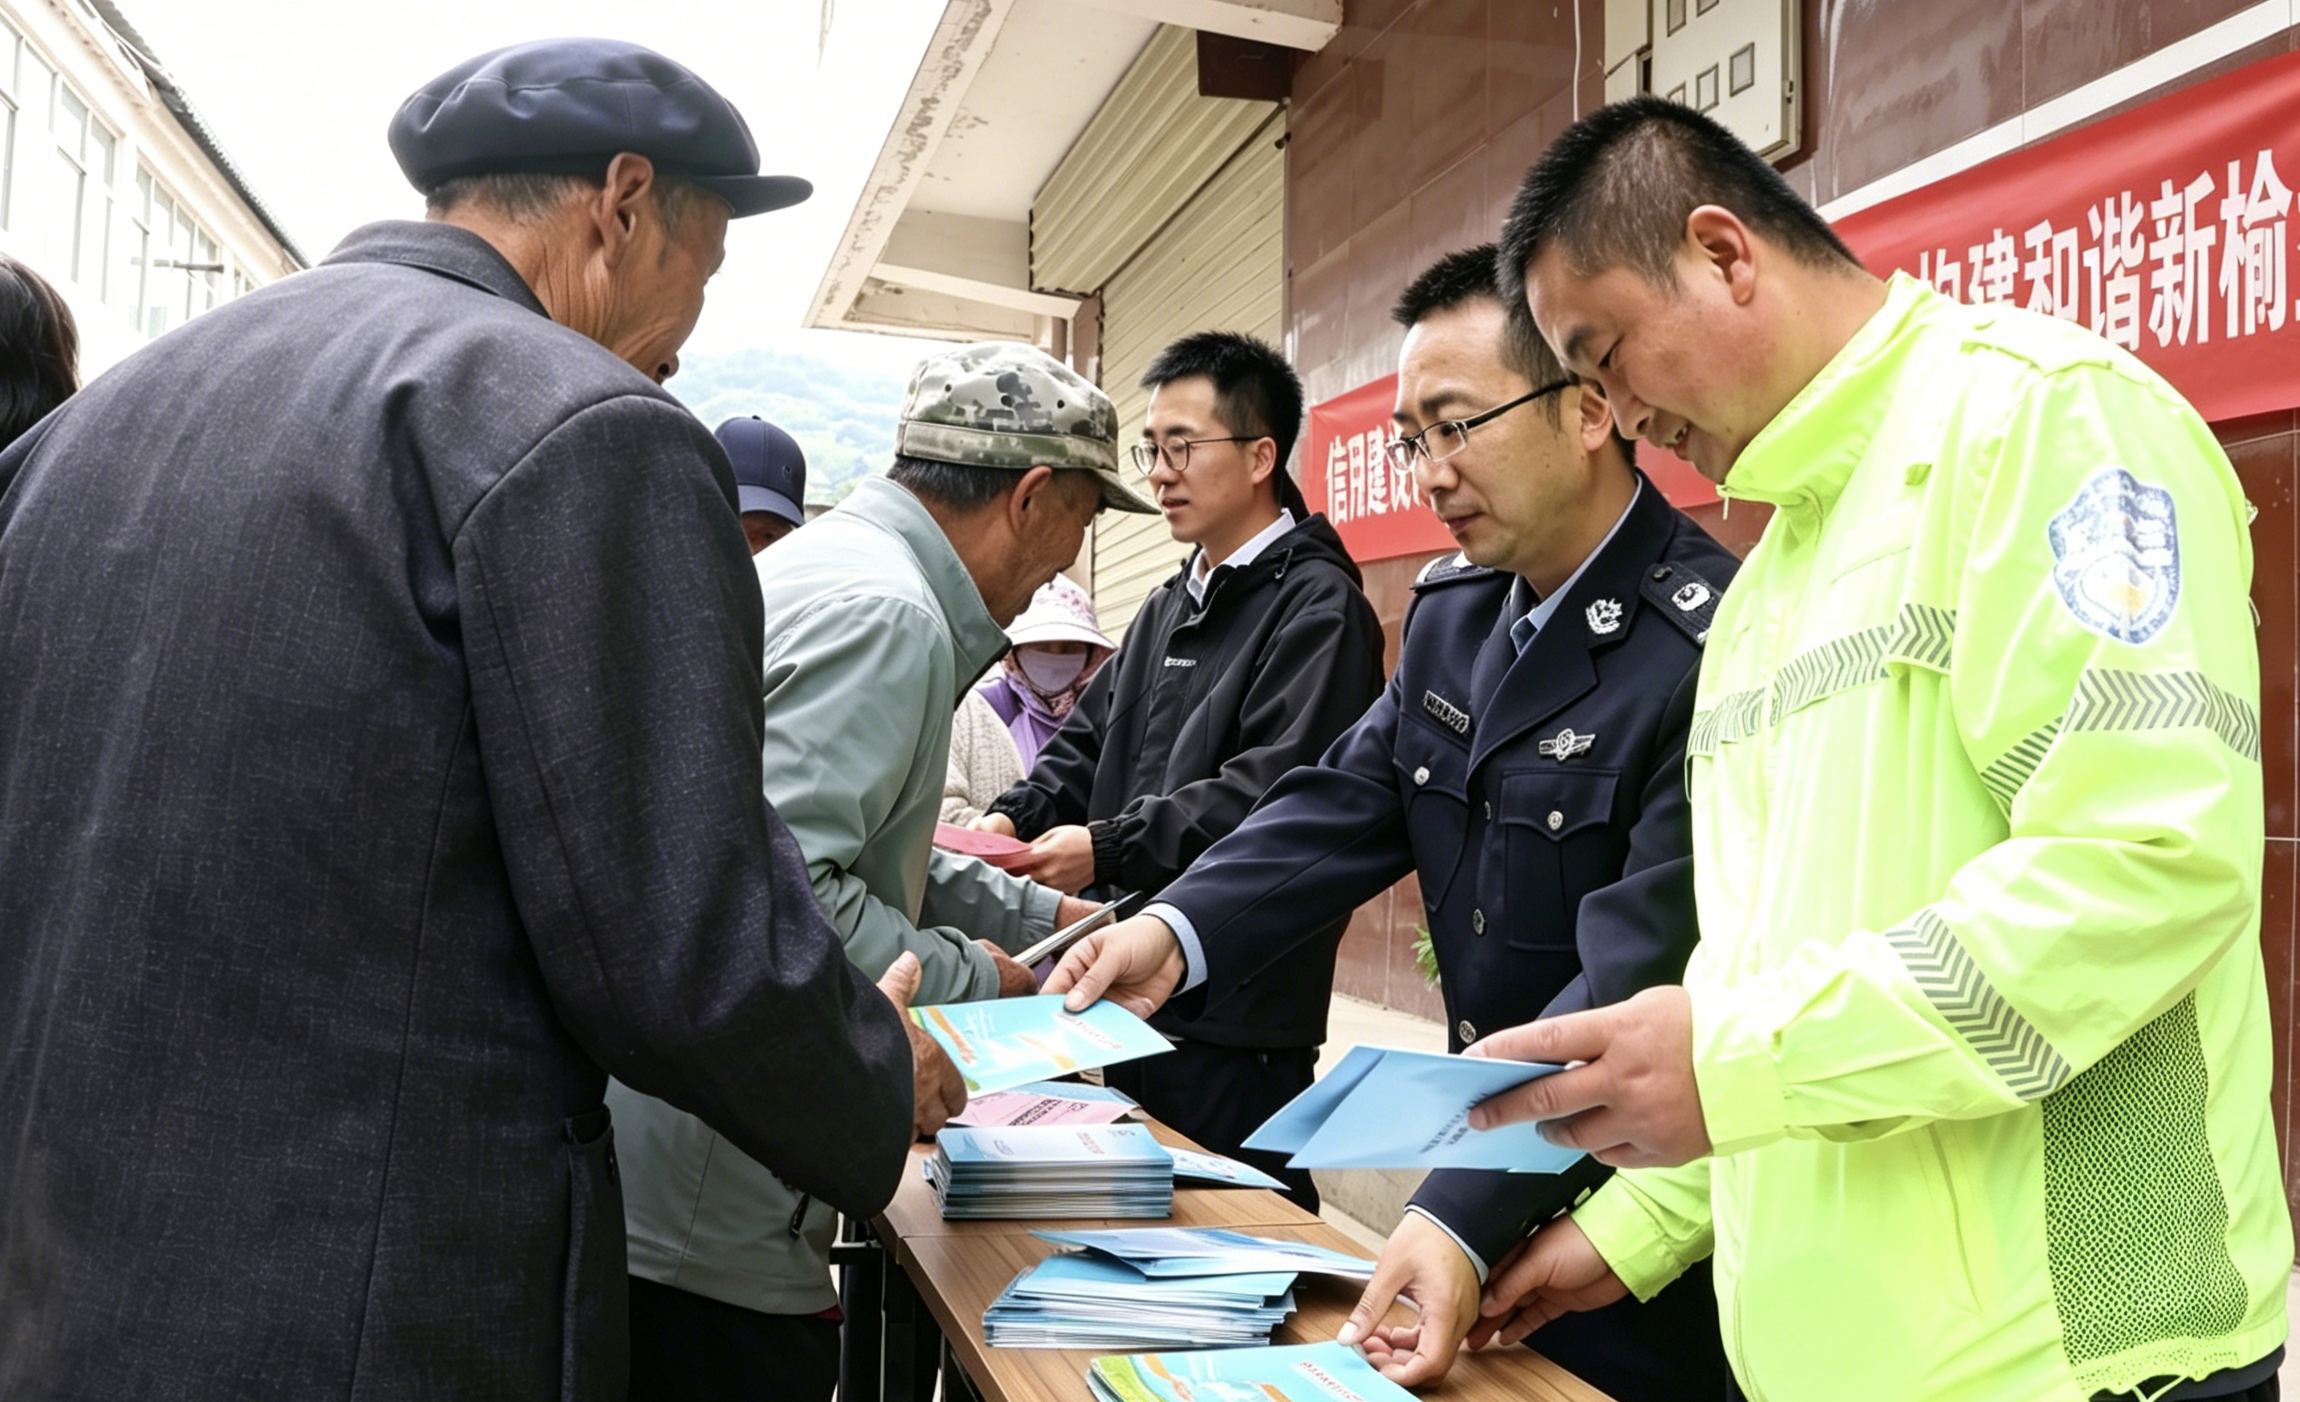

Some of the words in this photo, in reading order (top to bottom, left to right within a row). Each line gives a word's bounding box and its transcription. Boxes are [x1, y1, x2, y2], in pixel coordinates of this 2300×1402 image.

[1920, 149, 2300, 352] 建和谐新榆
